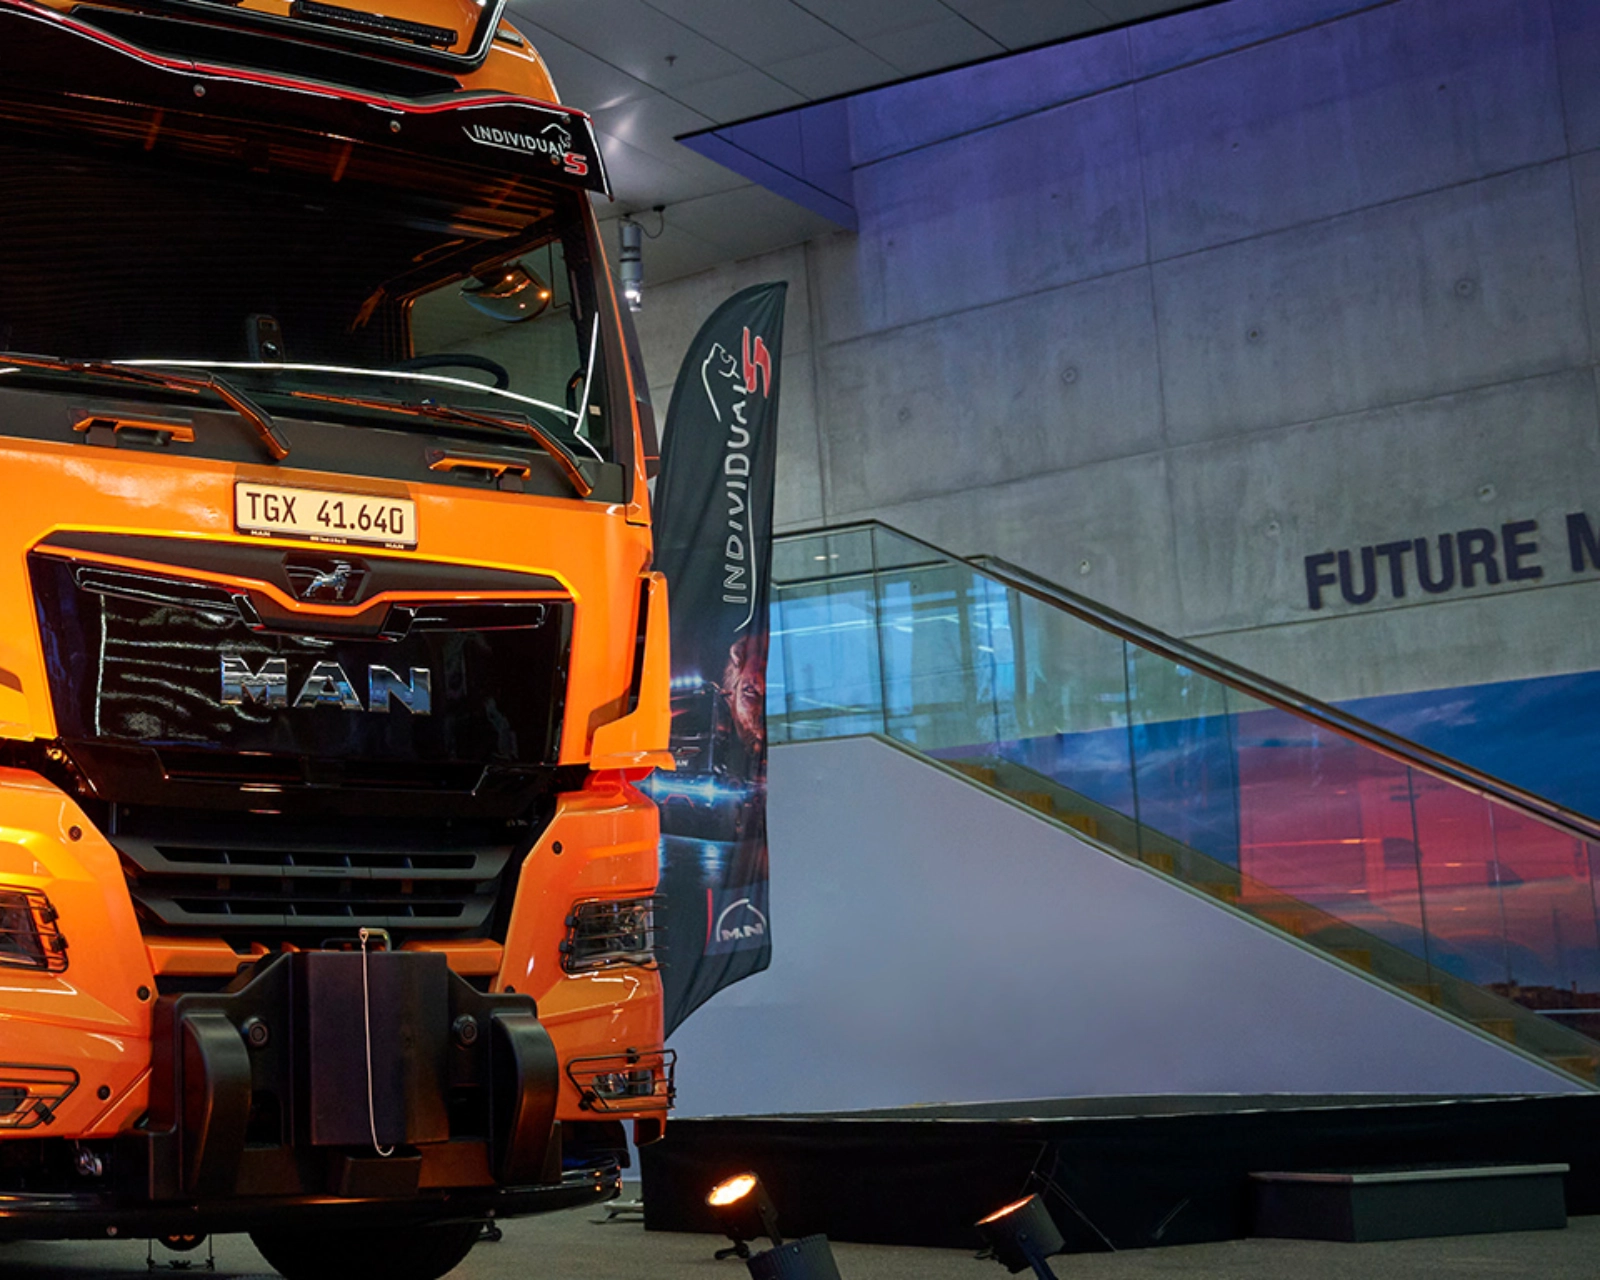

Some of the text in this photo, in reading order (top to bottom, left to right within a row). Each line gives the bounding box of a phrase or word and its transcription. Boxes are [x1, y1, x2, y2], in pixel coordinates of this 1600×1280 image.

[473, 124, 587, 175] INDIVIDUAL S
[246, 491, 404, 535] TGX 41.640
[723, 384, 750, 604] INDIVIDUAL
[1304, 519, 1544, 611] FUTURE
[220, 656, 431, 715] MAN
